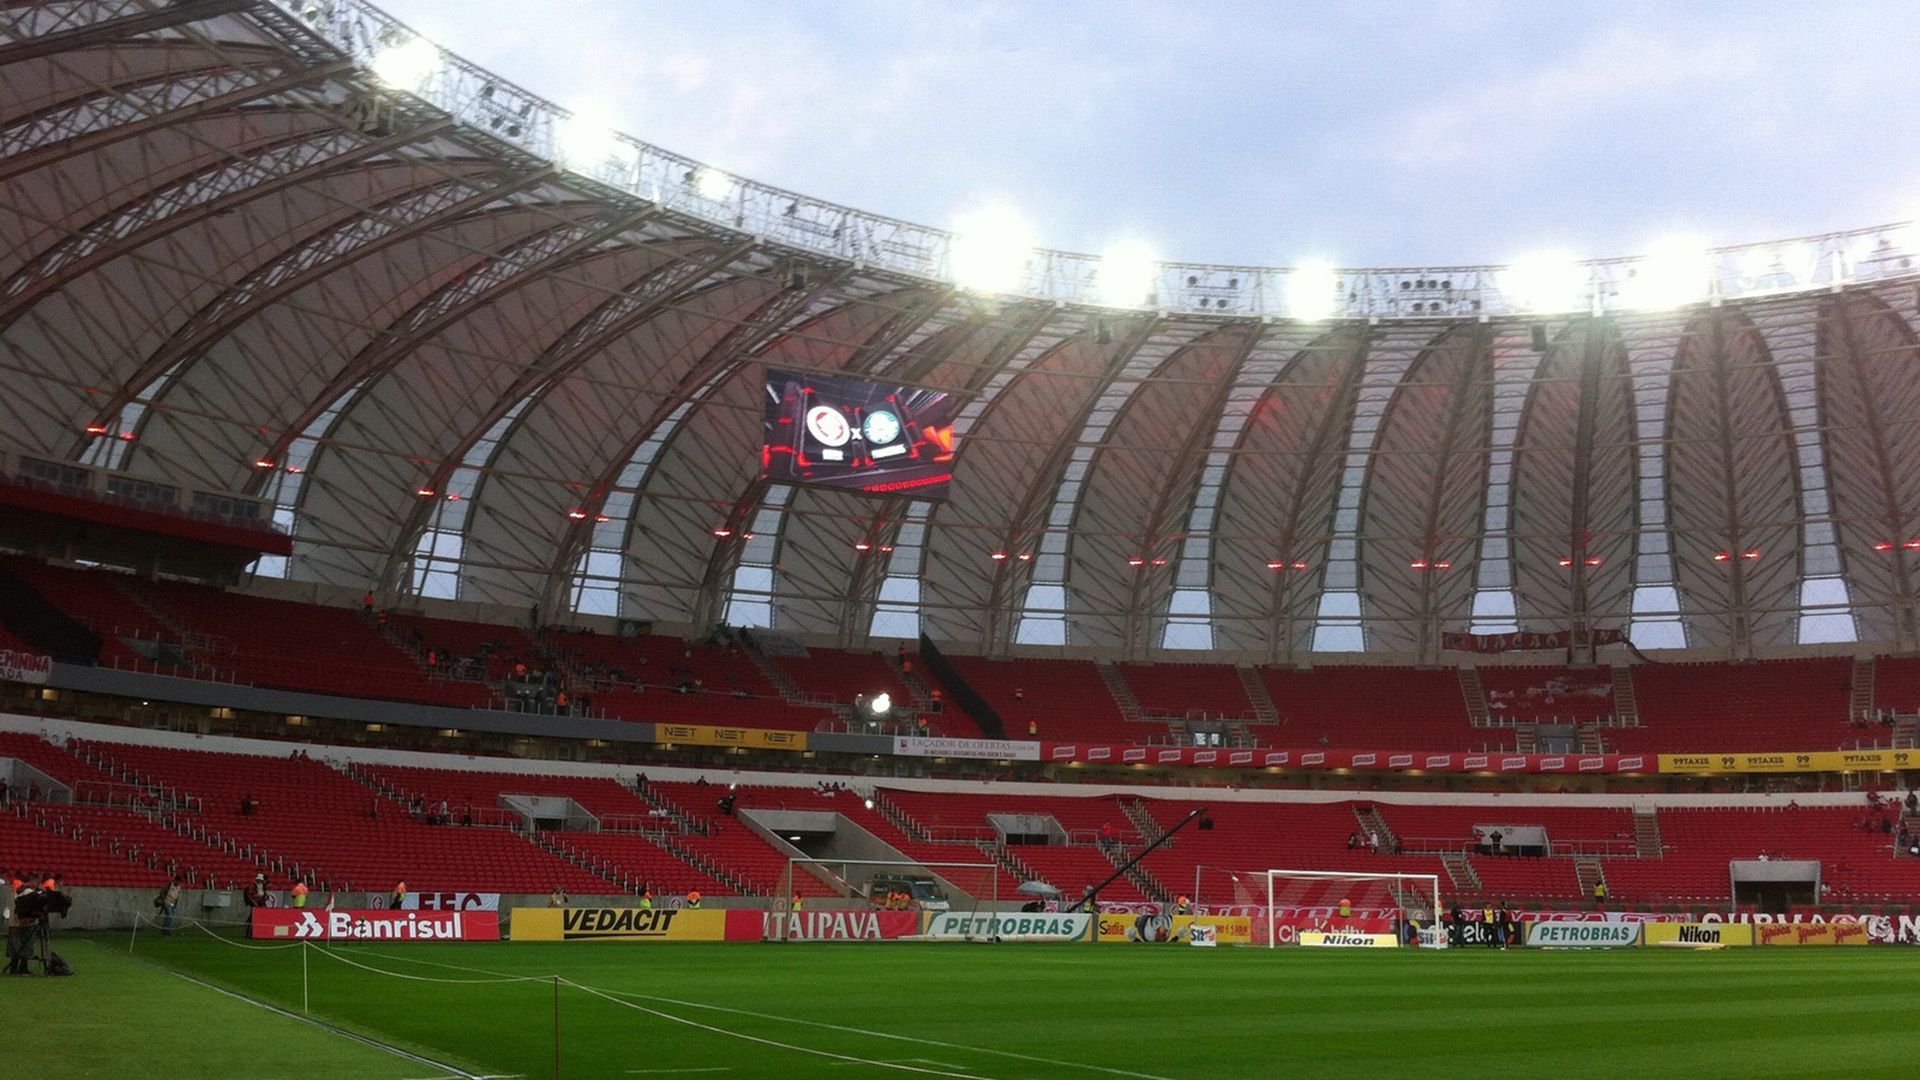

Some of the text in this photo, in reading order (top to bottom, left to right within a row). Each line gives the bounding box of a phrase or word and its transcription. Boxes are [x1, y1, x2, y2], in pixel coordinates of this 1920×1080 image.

[664, 727, 796, 742] NET NET NET
[330, 912, 462, 938] Banrisul
[563, 909, 677, 931] VEDACIT
[763, 911, 882, 939] ITAIPAVA
[944, 917, 1074, 935] PETROBRAS
[1099, 920, 1124, 935] Sadia
[1322, 935, 1375, 946] Nikon
[1539, 926, 1630, 941] PETROBRAS
[1678, 926, 1721, 943] Nikon
